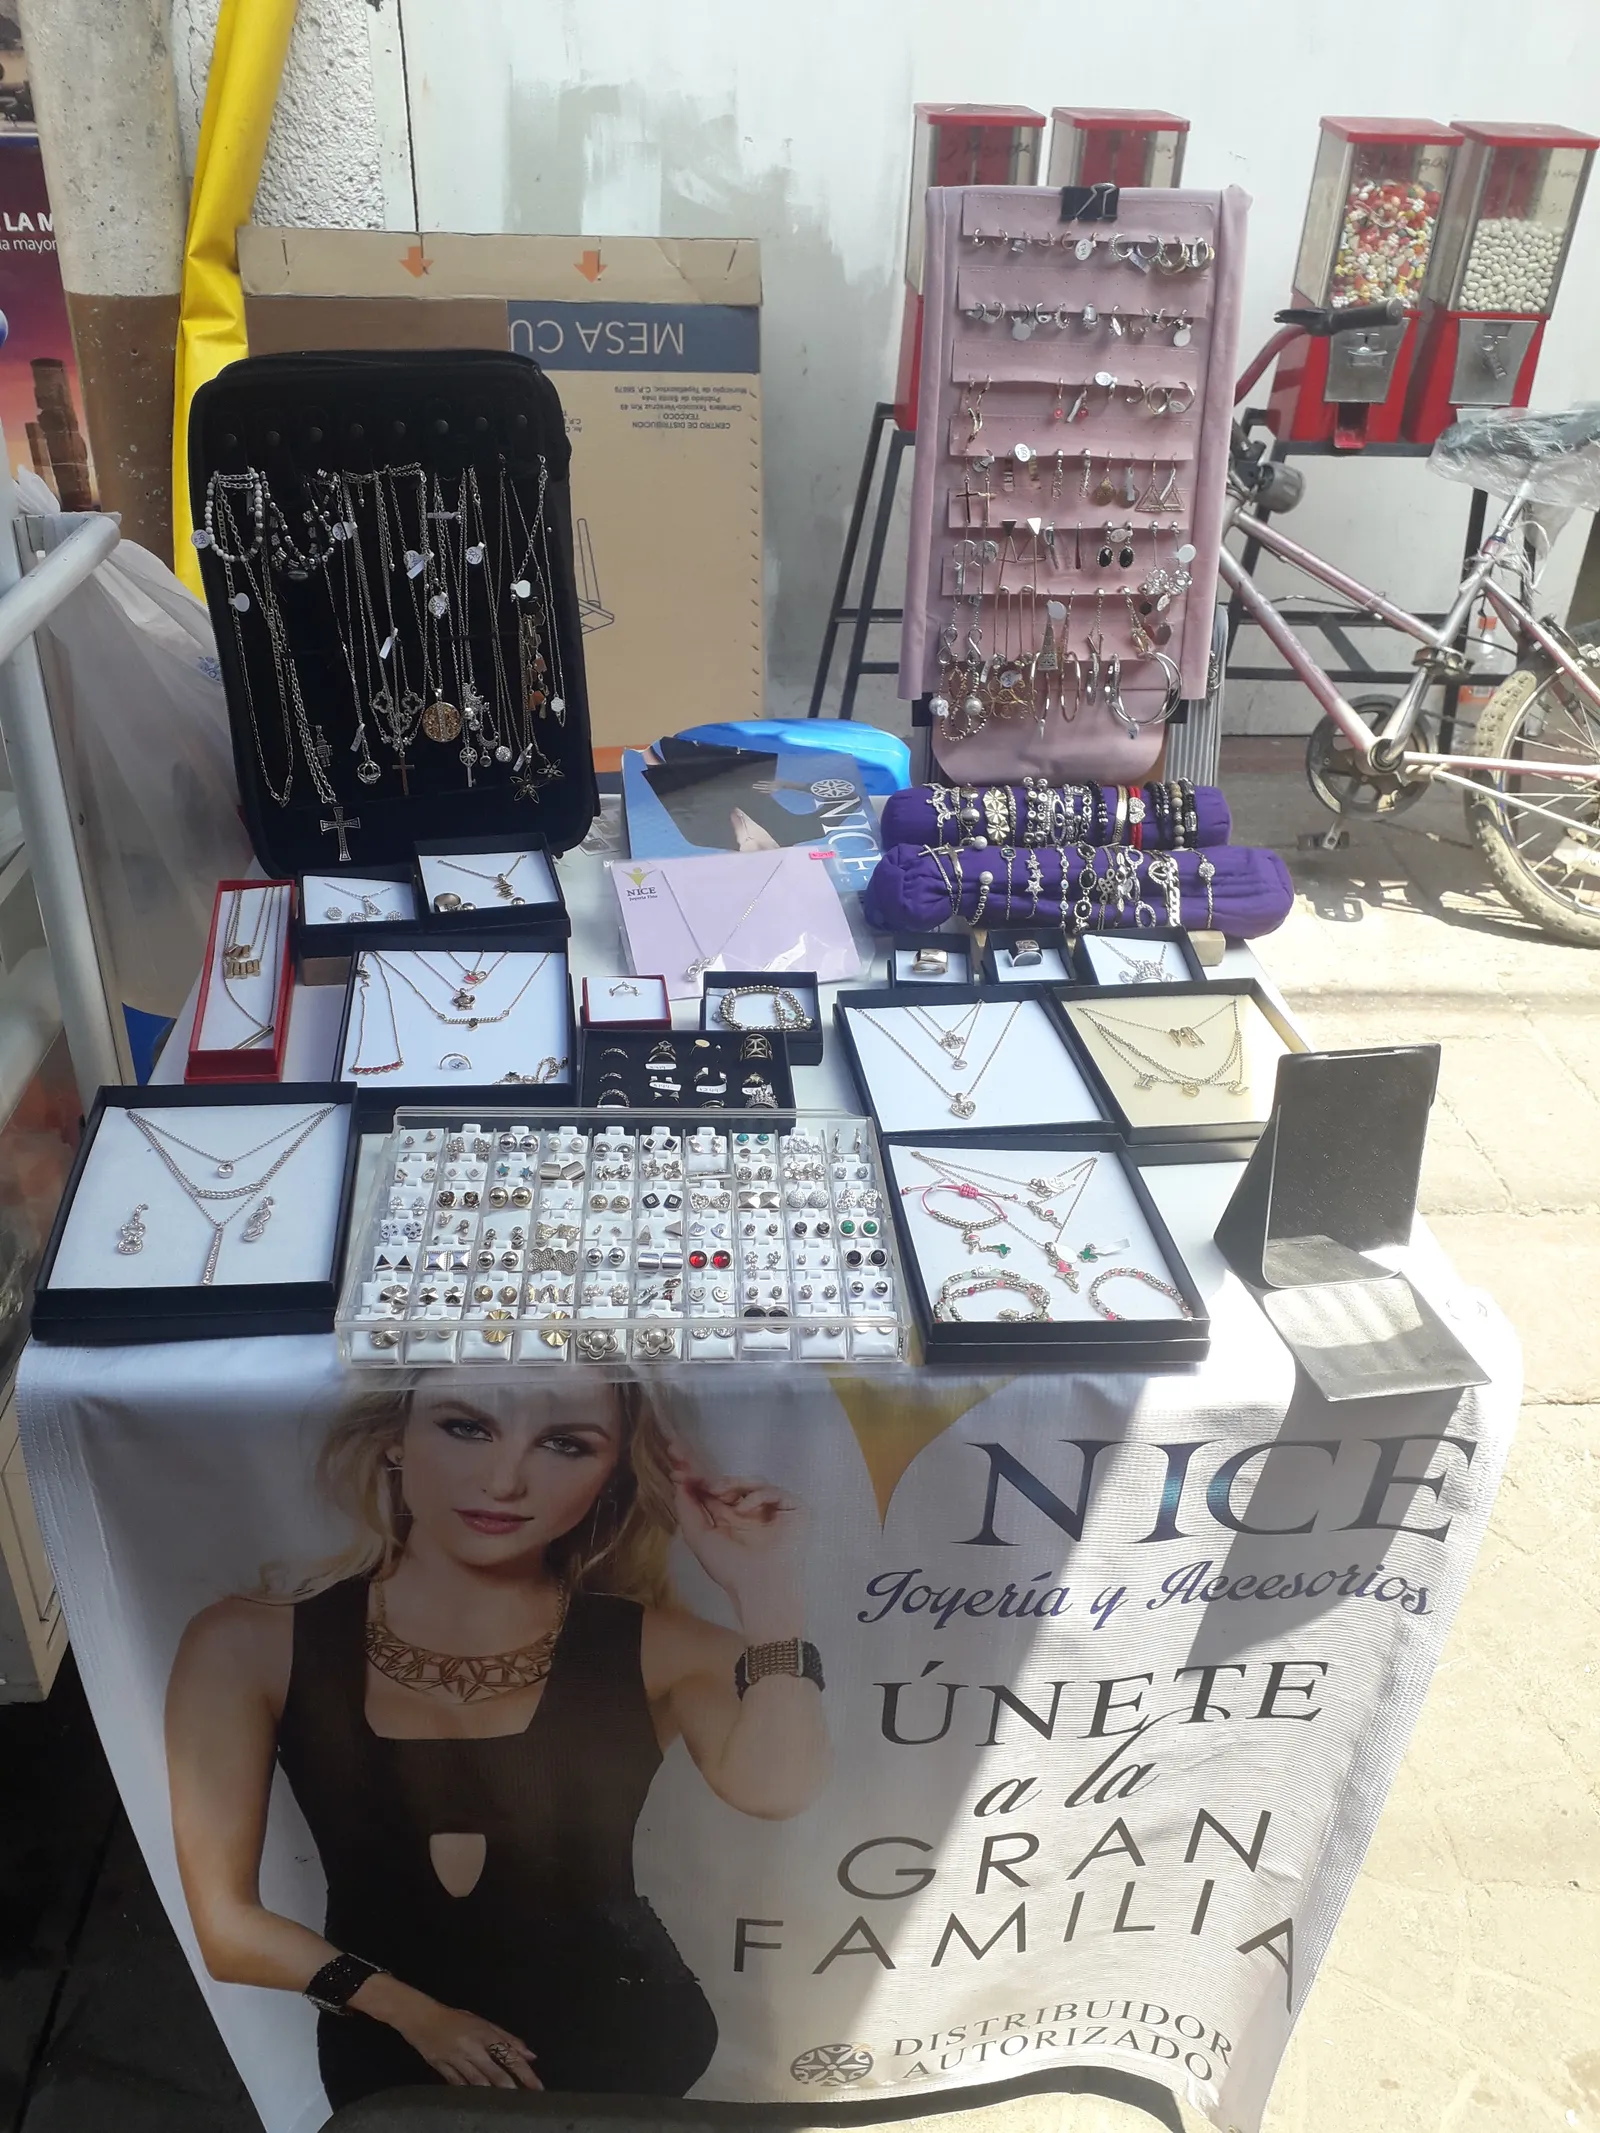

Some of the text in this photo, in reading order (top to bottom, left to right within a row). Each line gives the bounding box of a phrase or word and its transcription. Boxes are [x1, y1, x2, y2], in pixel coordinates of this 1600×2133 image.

[3, 212, 35, 232] LA
[13, 239, 57, 254] mayor
[575, 321, 684, 355] MESA
[626, 887, 657, 897] NICE
[951, 1435, 1478, 1547] NICE
[857, 1560, 1432, 1631] Joyería y Accesorios
[872, 1660, 1329, 1747] ÚNETE
[973, 1706, 1232, 1818] a la
[837, 1807, 1272, 1901] GRAN
[733, 1879, 1293, 2015] FAMILIA
[894, 1999, 1233, 2069] DISTRIBUIDOR
[903, 2026, 1213, 2081] AUTORIZADO
